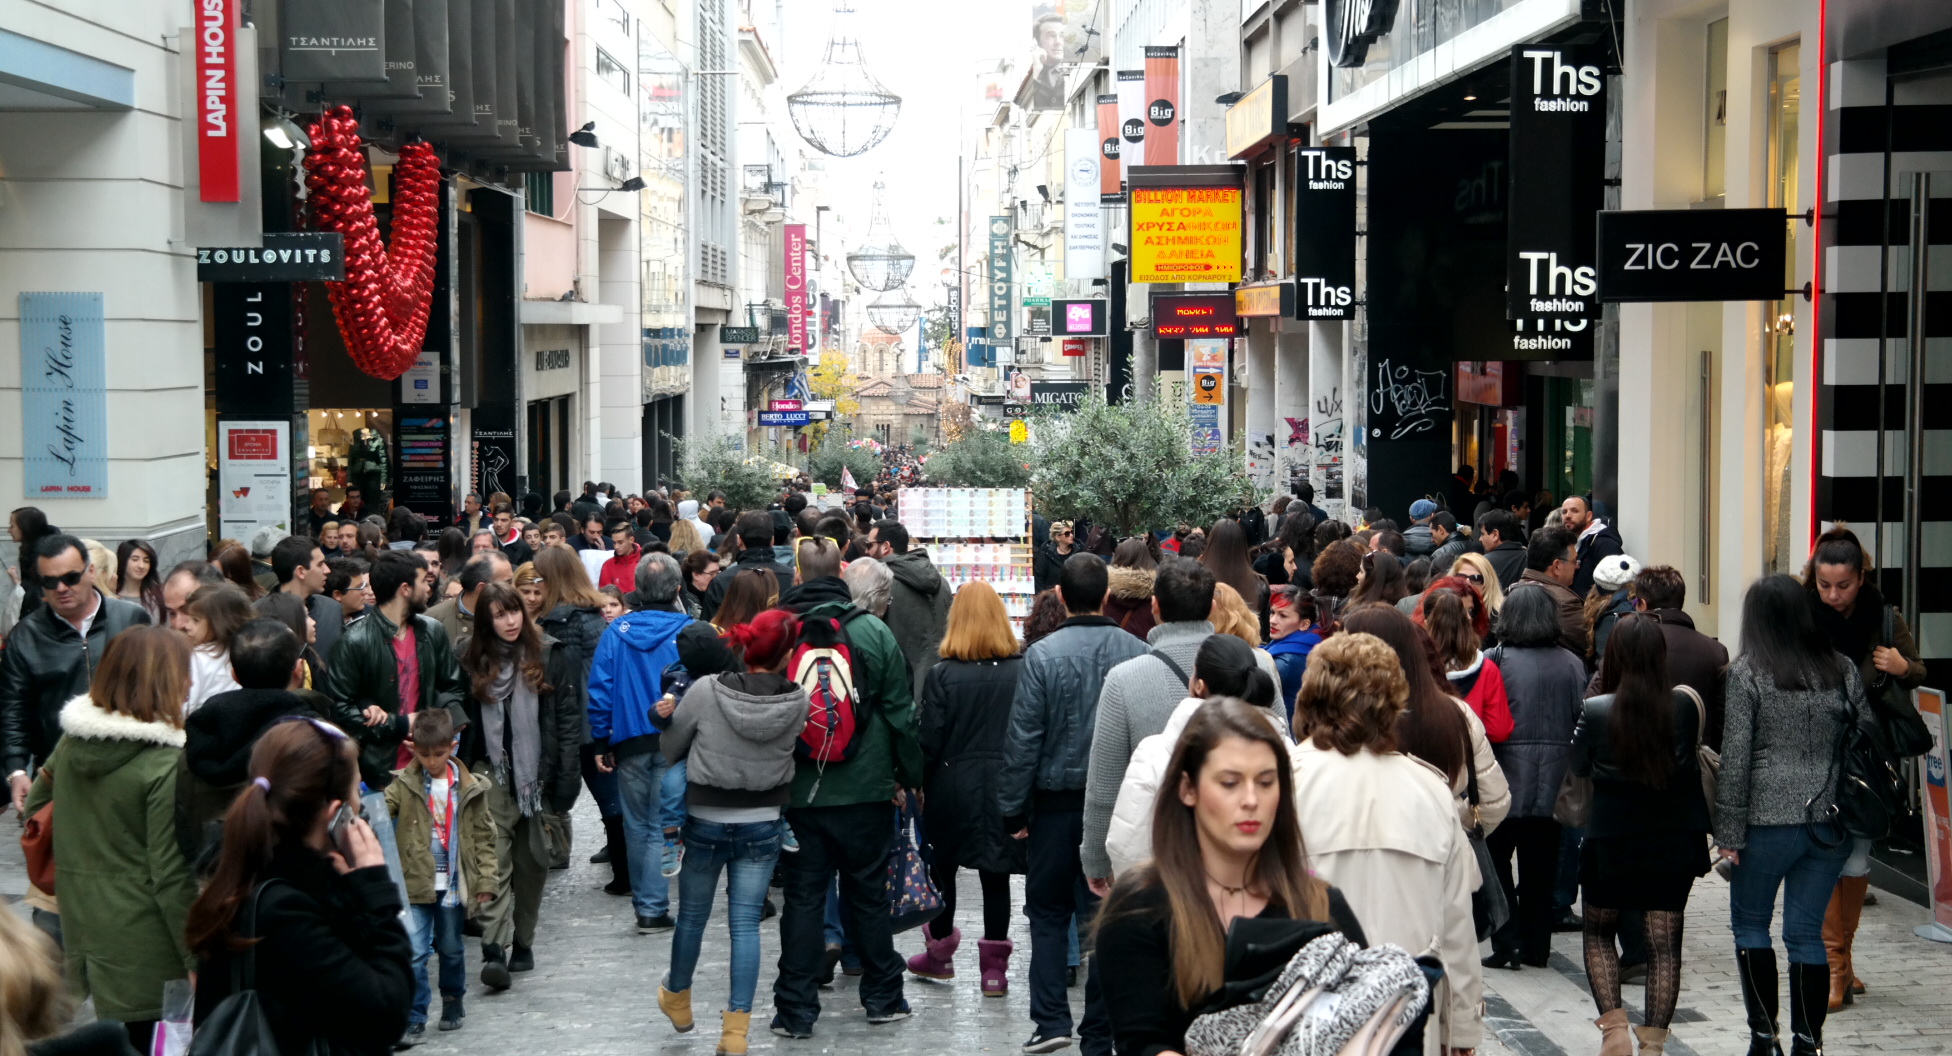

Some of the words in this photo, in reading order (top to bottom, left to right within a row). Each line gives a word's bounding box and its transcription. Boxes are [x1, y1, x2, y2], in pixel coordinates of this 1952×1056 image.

[290, 37, 376, 46] ΤΣΑΝΤΙΛΗΣ
[1523, 51, 1601, 95] Ths
[206, 70, 226, 136] LAPIN
[1534, 98, 1588, 112] fashion
[1151, 106, 1174, 118] Big
[1125, 125, 1144, 137] Big
[1301, 151, 1352, 179] Ths
[1309, 180, 1344, 190] fashion
[1135, 190, 1182, 203] BILLION
[1187, 190, 1237, 203] MARKET
[1160, 207, 1214, 218] ΑΓΟΡΑ
[1136, 221, 1236, 232] ΧΡΥΣΑΦΙΚΩΝ
[1144, 236, 1228, 246] ΑΣΗΜΙΚΩΝ
[199, 249, 331, 264] ZOULOVITS
[1156, 249, 1216, 259] ΔΑΝΕΙΑ
[1624, 243, 1680, 270] ZIC
[1690, 242, 1760, 269] ZAC
[786, 234, 802, 290] Center
[1519, 252, 1596, 296] Ths
[994, 240, 1007, 339] ΦΕΤΟΥΡΗ
[1301, 278, 1352, 306] Ths
[1308, 306, 1343, 316] fashion
[1530, 298, 1584, 312] fashion
[246, 292, 263, 374] ZOUL
[1514, 335, 1571, 349] fashion
[46, 315, 74, 388] House
[47, 398, 84, 476] Lapin
